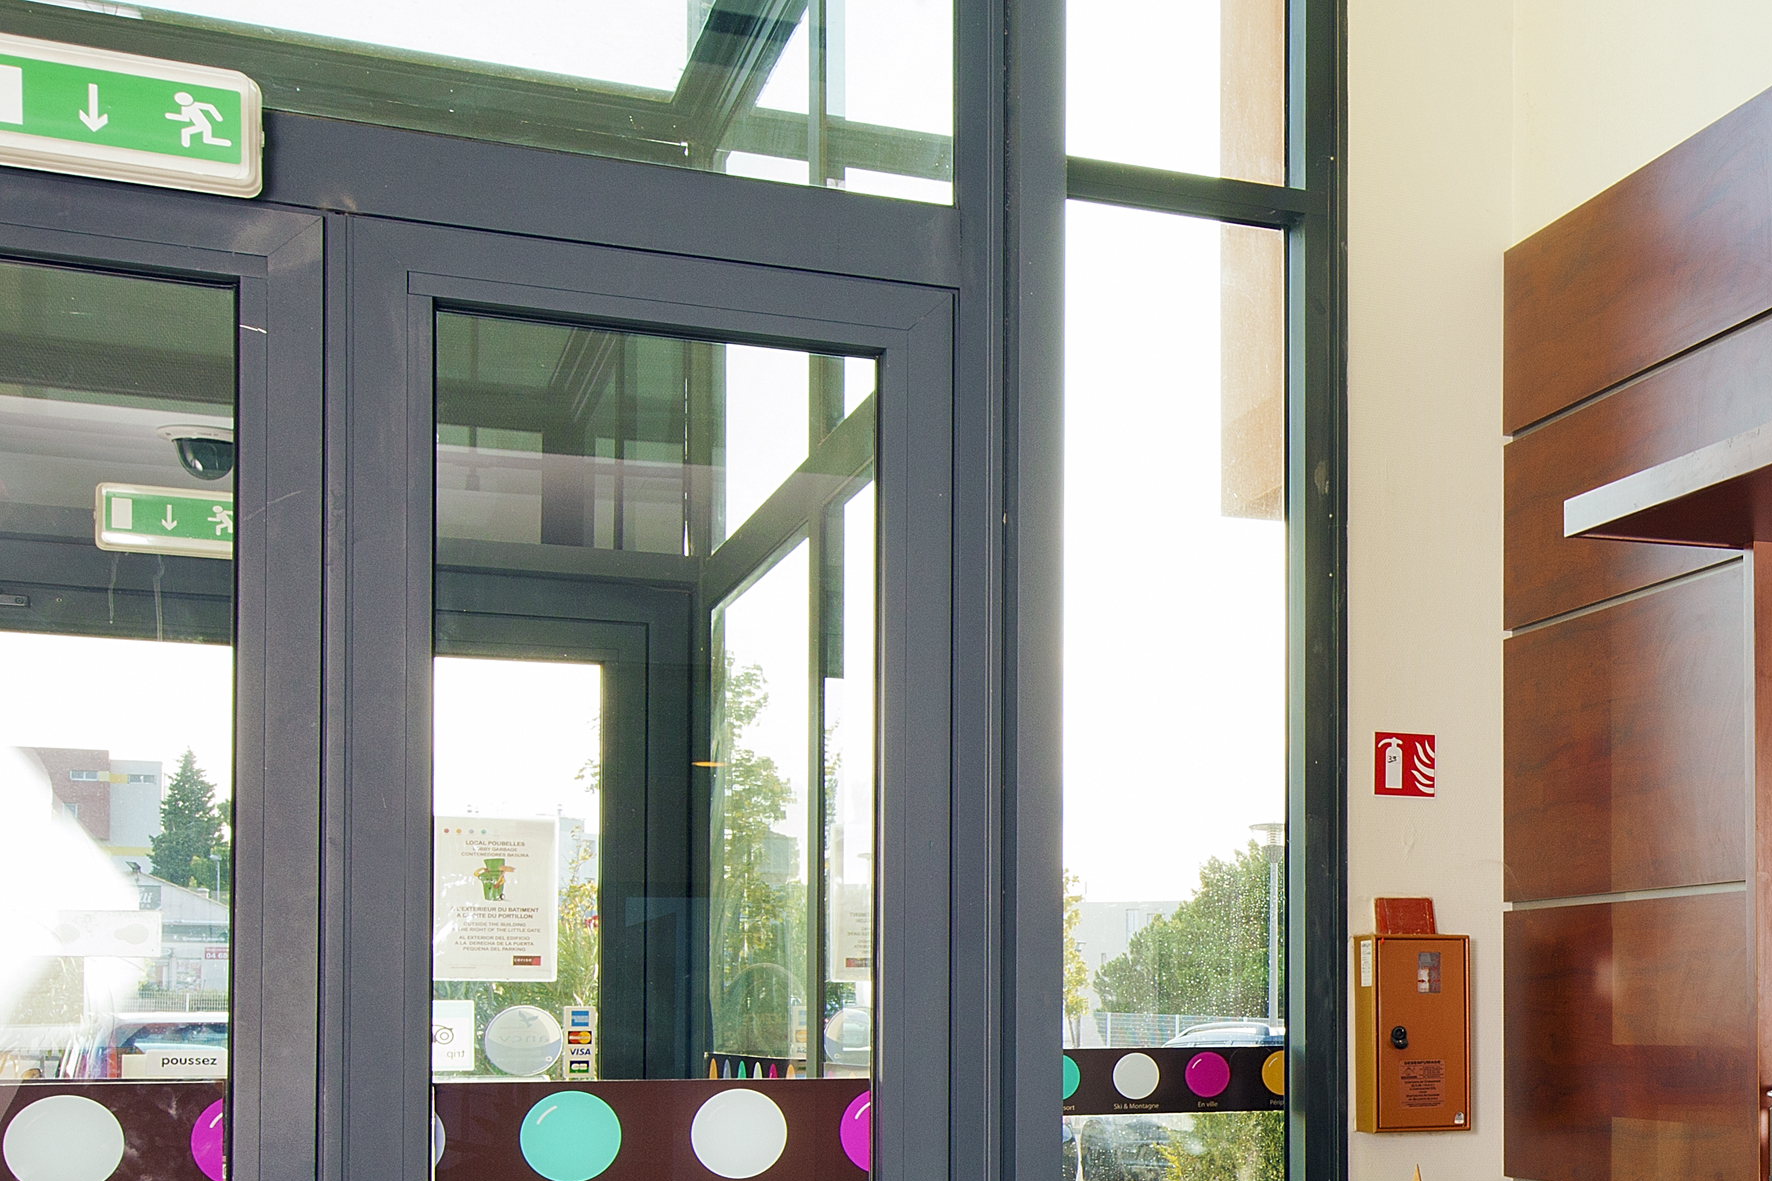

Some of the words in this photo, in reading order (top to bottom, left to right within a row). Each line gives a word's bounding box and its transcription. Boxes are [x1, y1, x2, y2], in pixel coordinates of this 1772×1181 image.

[161, 1055, 217, 1067] poussez
[1113, 1102, 1122, 1110] Ski
[1123, 1102, 1129, 1110] &
[1129, 1102, 1160, 1111] Montagne
